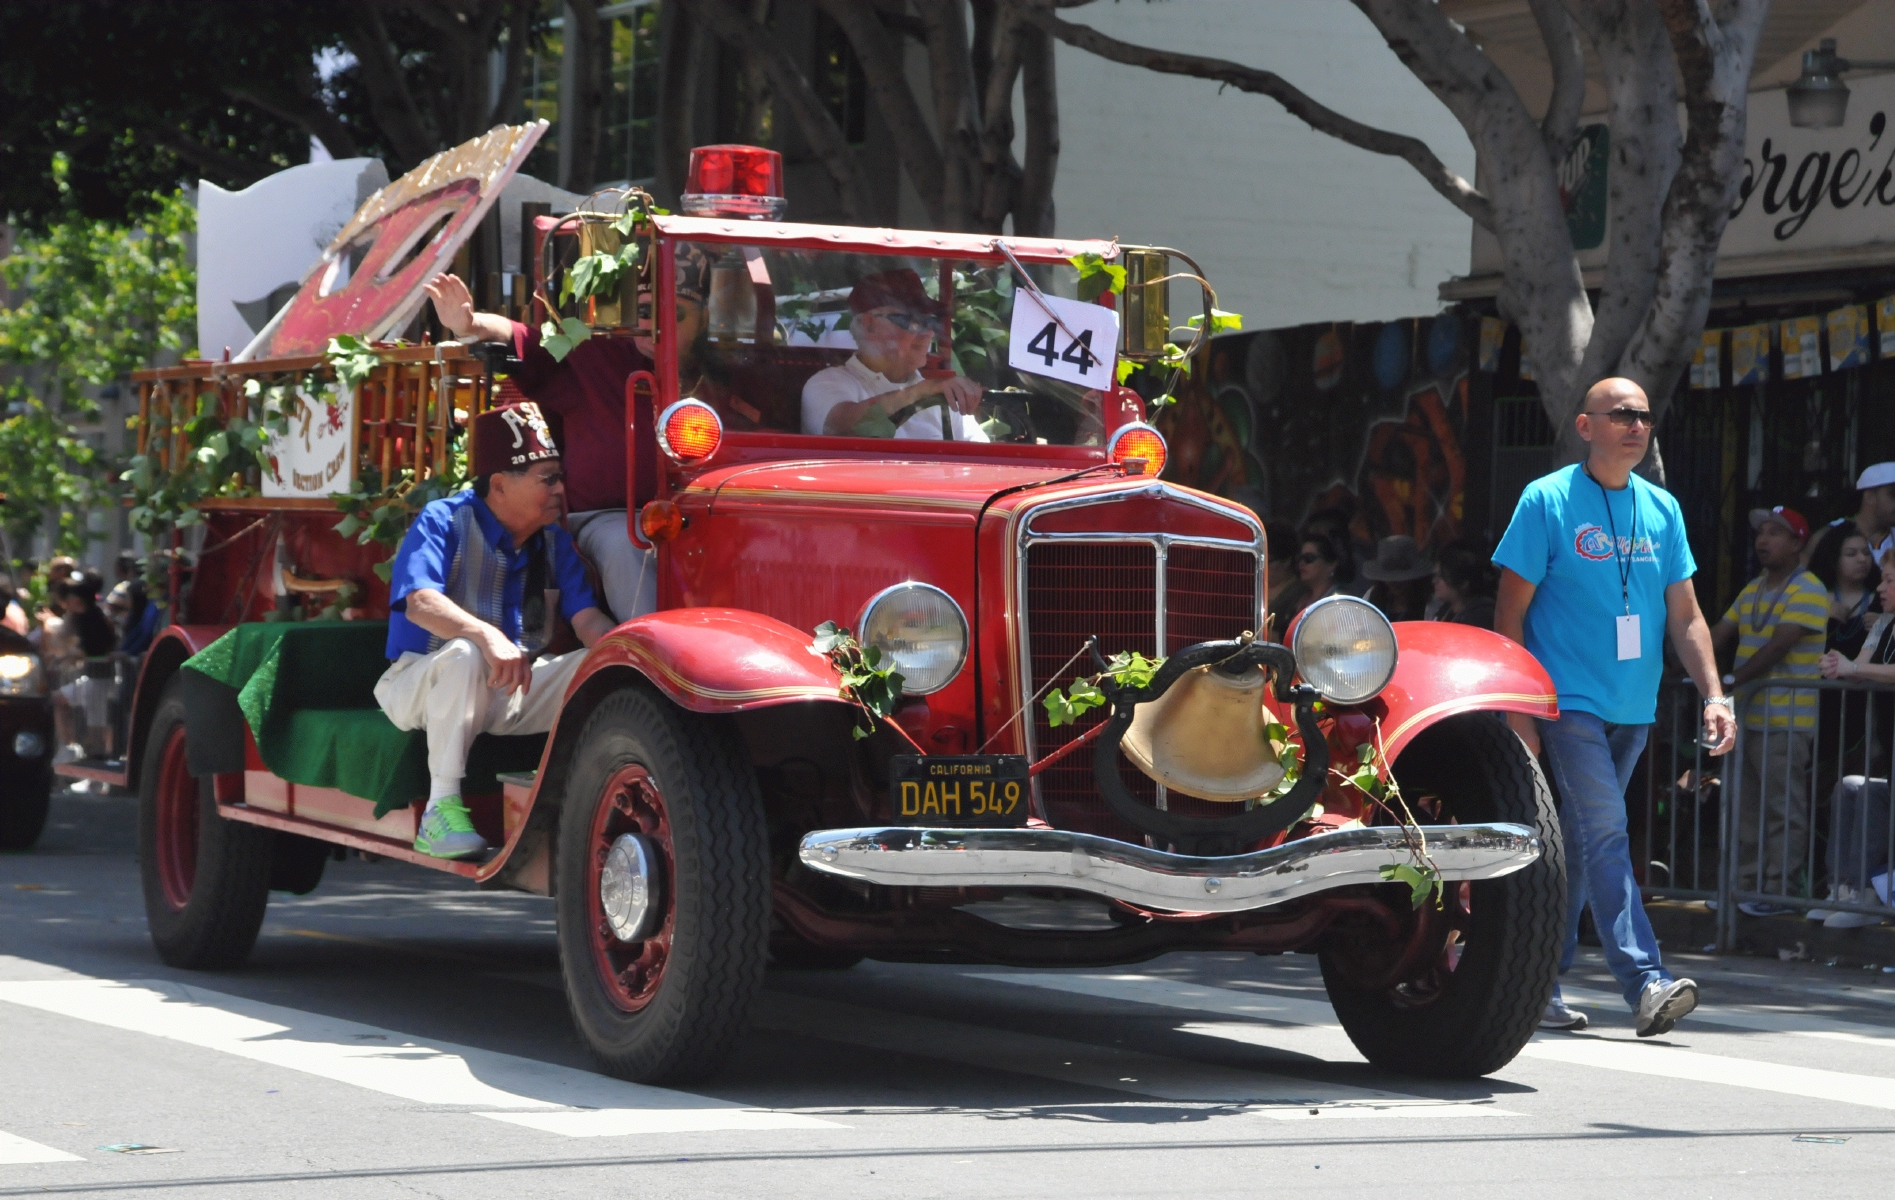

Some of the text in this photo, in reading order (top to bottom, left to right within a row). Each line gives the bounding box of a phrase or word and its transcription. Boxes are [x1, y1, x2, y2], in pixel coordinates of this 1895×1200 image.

[1027, 321, 1094, 376] 44
[511, 454, 526, 465] 20
[930, 764, 992, 775] CALIFORNIA
[901, 781, 1020, 816] DAH 549
